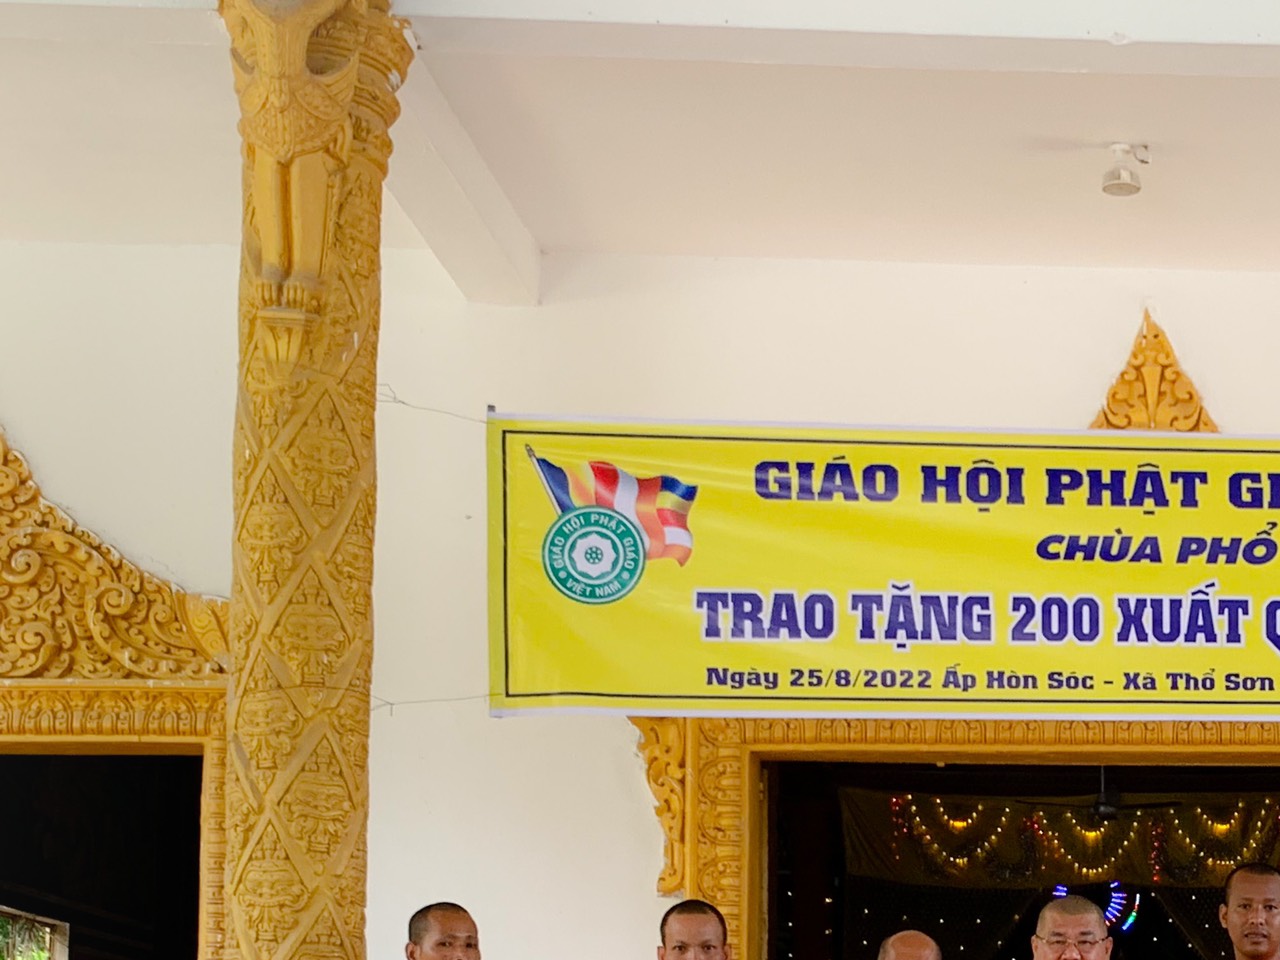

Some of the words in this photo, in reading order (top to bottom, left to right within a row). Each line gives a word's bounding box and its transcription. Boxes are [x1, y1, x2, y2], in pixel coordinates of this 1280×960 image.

[755, 455, 898, 500] GIÁO
[921, 460, 1024, 511] HỘI
[1046, 464, 1207, 514] PHẬT
[551, 539, 565, 569] GIÁO
[562, 517, 585, 534] HỘI
[590, 514, 627, 533] PHẬT
[623, 538, 638, 570] GIÁO
[1037, 529, 1161, 562] CHÙA
[1177, 522, 1277, 564] PHỔ
[566, 578, 592, 596] VIỆT
[595, 581, 622, 597] NAM
[697, 592, 833, 638] TRAO
[852, 584, 991, 648] TẶNG
[1012, 597, 1099, 641] 200
[1119, 582, 1248, 643] XUẤT
[707, 668, 778, 689] Ngày
[790, 669, 931, 687] 25/8/2022
[942, 664, 975, 691] Ấp
[987, 671, 1037, 688] Hòn
[1048, 672, 1093, 689] Sóc
[1124, 673, 1156, 690] Xã
[1166, 667, 1214, 690] Thổ
[1225, 674, 1274, 690] Sơn
